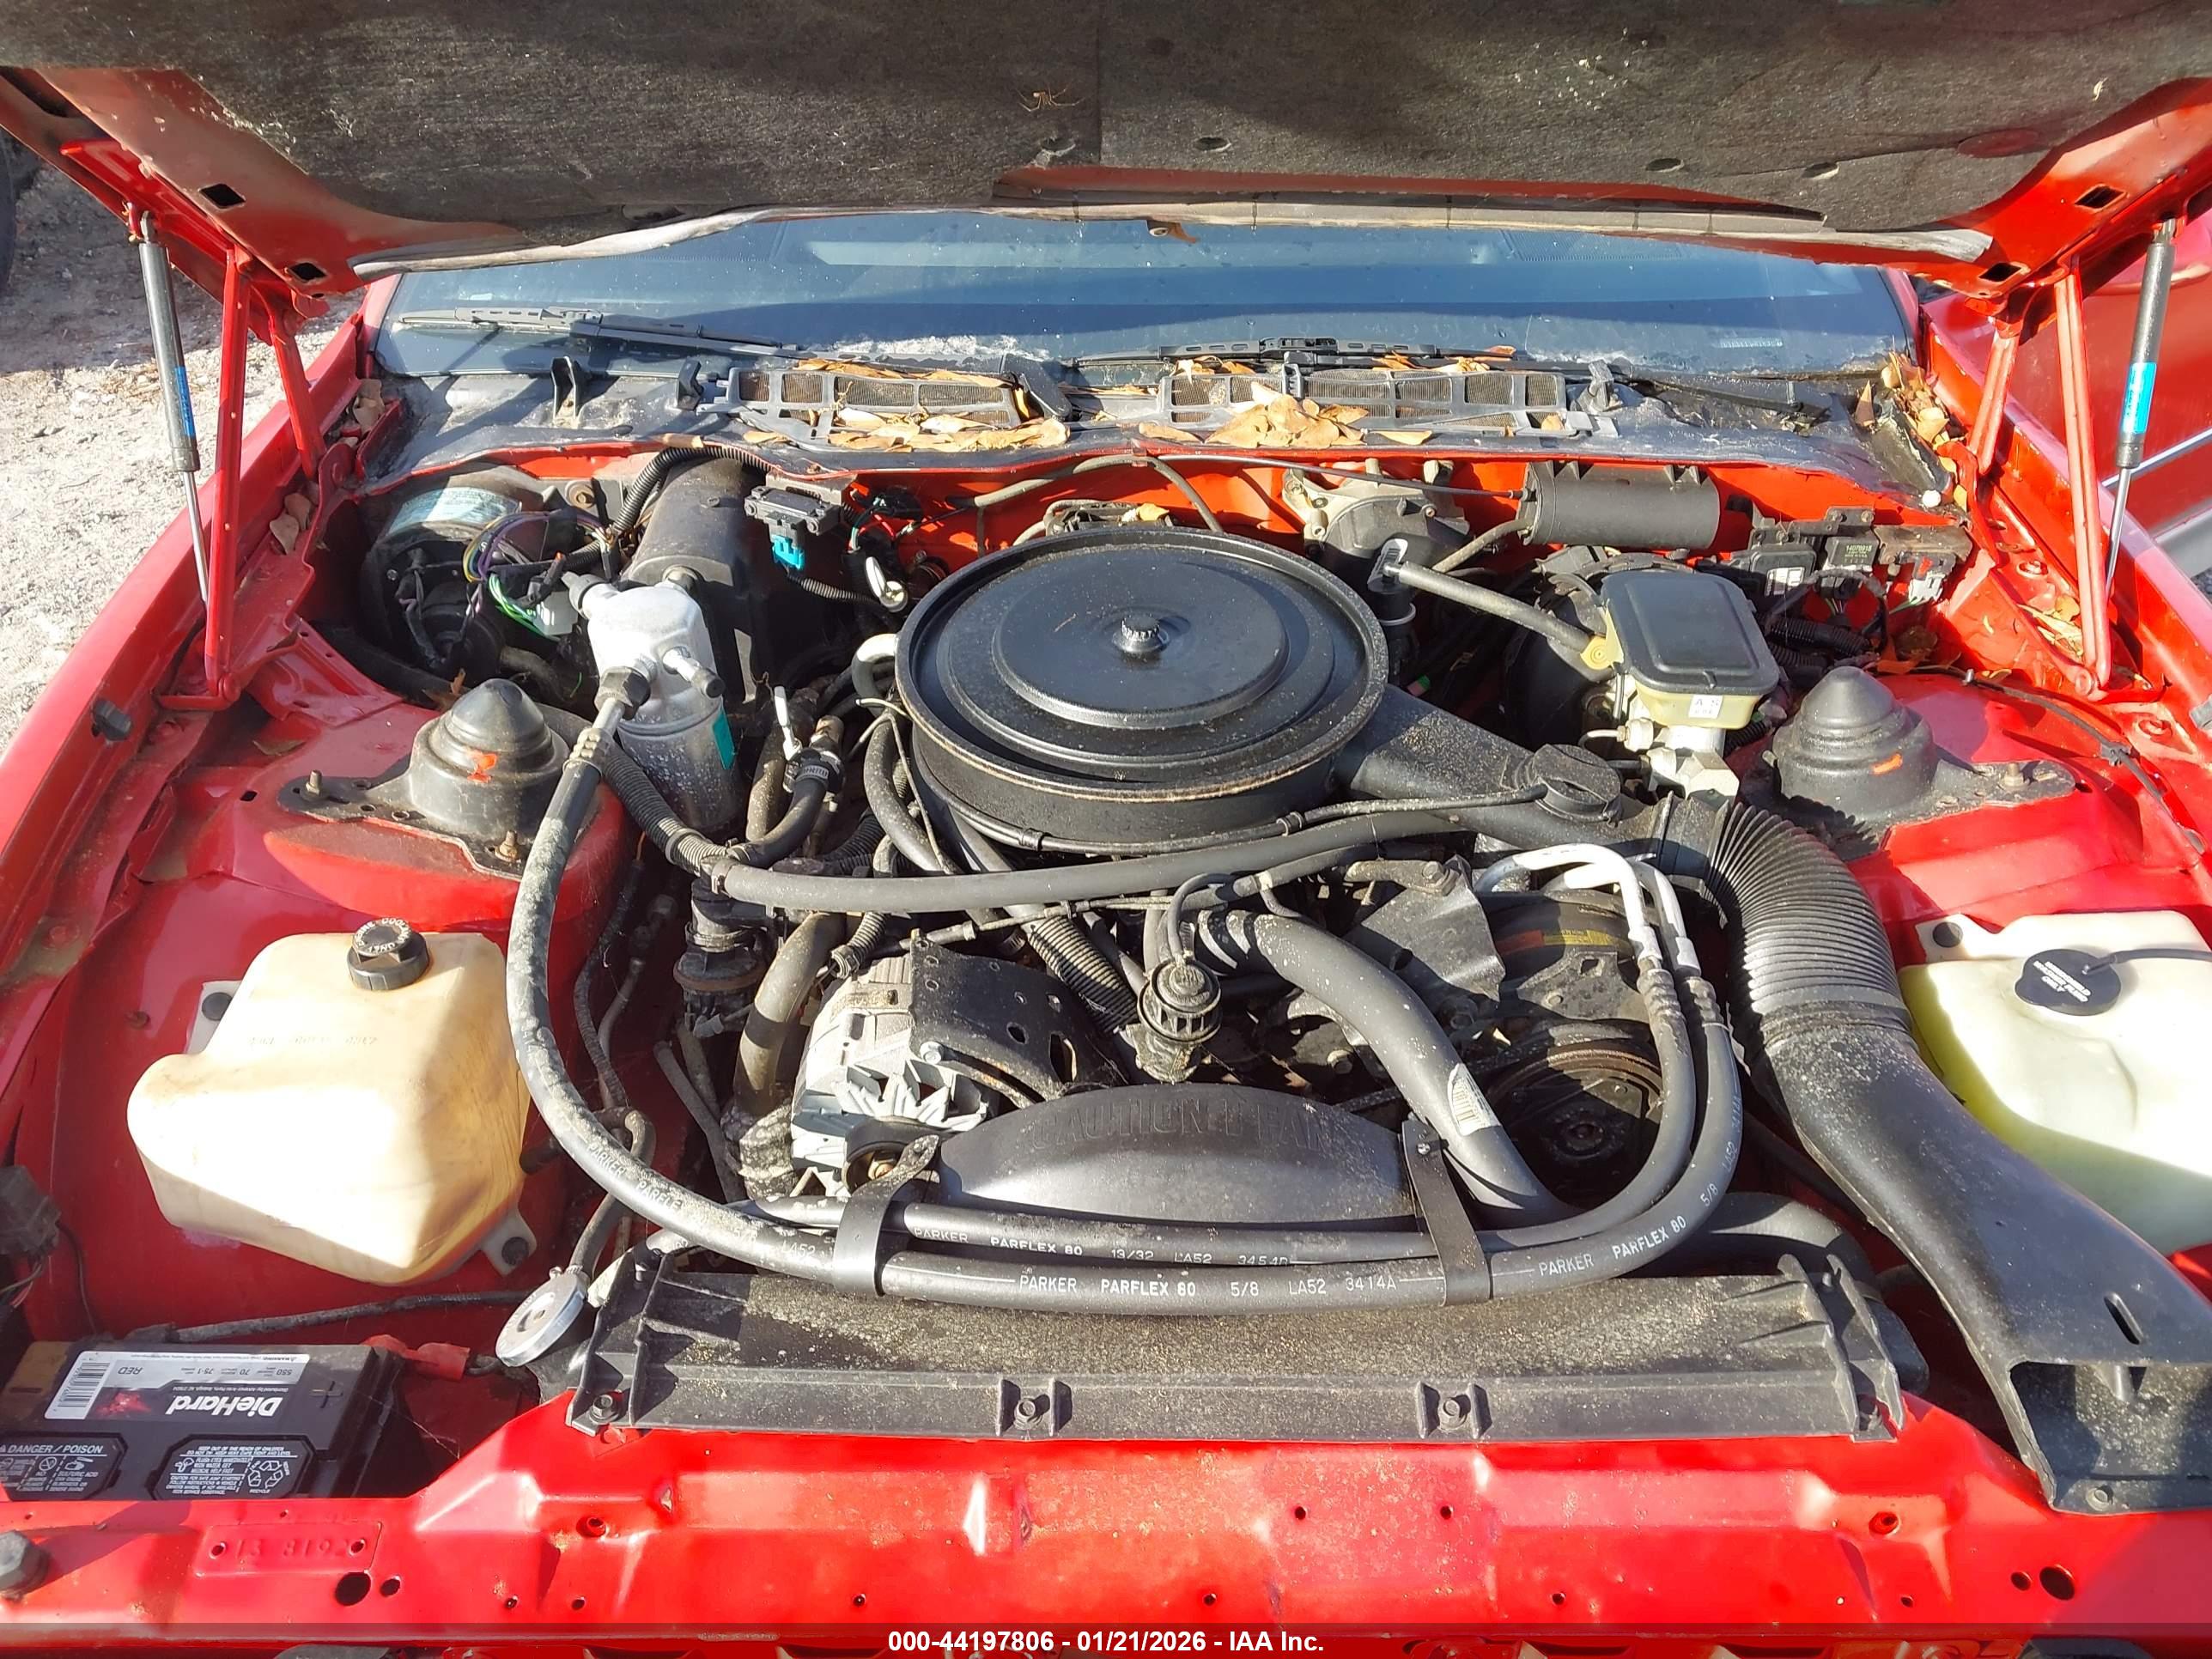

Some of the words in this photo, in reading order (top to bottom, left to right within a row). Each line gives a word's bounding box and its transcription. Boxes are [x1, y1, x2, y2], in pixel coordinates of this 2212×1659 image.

[2041, 975, 2066, 992] ONLY
[589, 1143, 626, 1177] PARKER
[1539, 1253, 1595, 1276] PARKER
[1612, 1226, 1669, 1260] PARFLEX
[1700, 1182, 1718, 1207] 5/8
[914, 1228, 969, 1243] PARKER
[991, 1237, 1056, 1254] PARFLEX
[1065, 1246, 1083, 1256] 80
[1111, 1249, 1154, 1261] 13/32
[1019, 1275, 1077, 1293] PARKER
[1101, 1279, 1169, 1297] PARFLEX
[1177, 1281, 1196, 1297] 80
[1231, 1281, 1259, 1297] 5/8
[1288, 1279, 1327, 1295] LA52
[1346, 1276, 1397, 1292] 3414A
[166, 1395, 283, 1417] DieHard
[8, 1444, 53, 1454] DANGER
[63, 1444, 103, 1454] POISON
